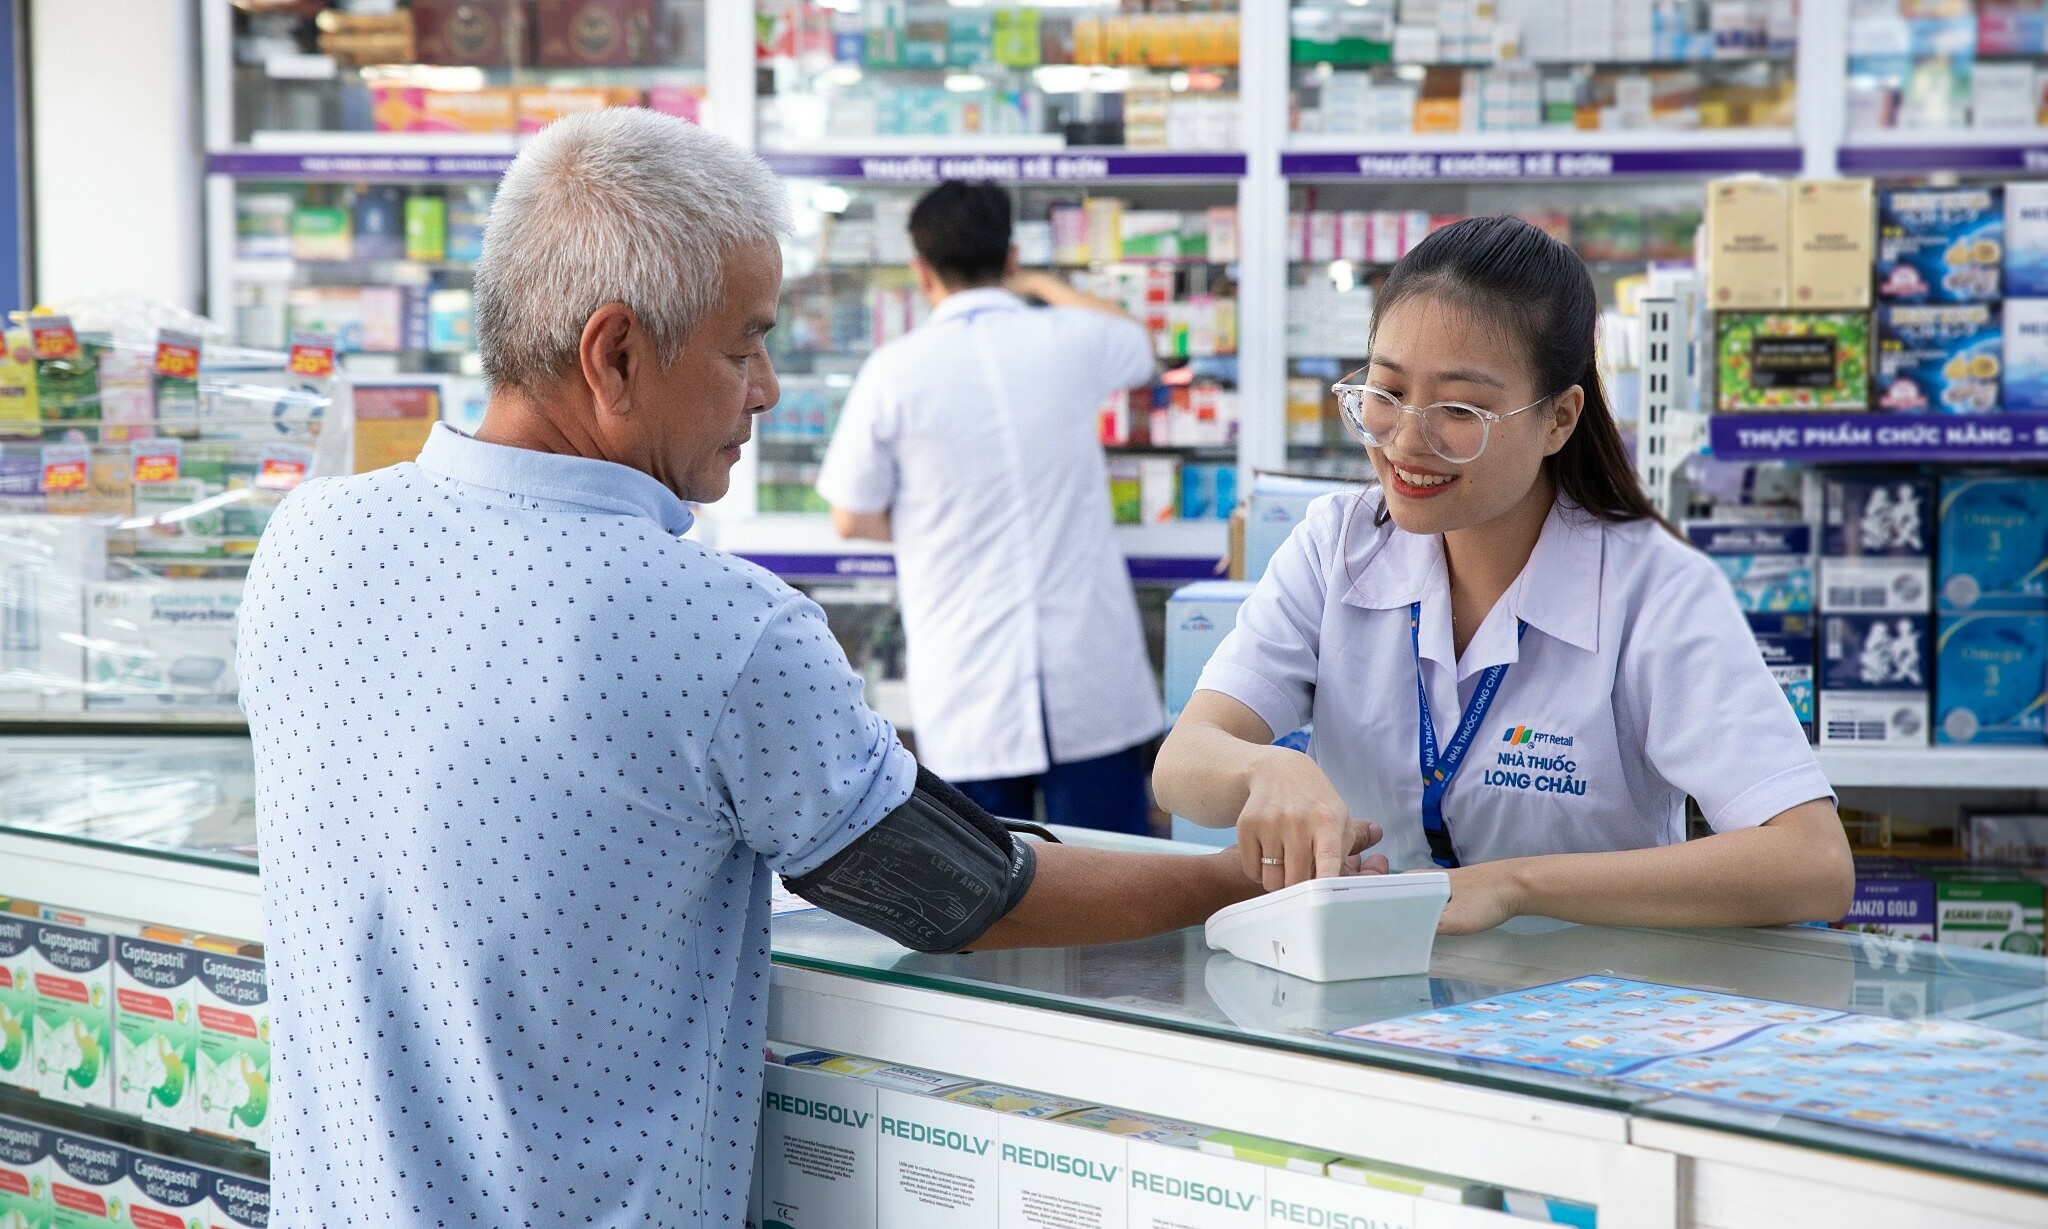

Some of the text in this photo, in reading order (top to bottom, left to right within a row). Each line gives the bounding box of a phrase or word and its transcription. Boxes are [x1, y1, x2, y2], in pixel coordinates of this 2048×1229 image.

[1422, 714, 1433, 745] THUỐC
[1447, 745, 1463, 763] NHÀ
[1458, 714, 1478, 744] THUỐC
[1473, 688, 1490, 715] LONG
[1534, 732, 1573, 746] FPT Retail
[1424, 747, 1434, 767] NHÀ
[1497, 751, 1577, 773] NHÀ THUỐC
[1484, 770, 1587, 796] LONG CHÂU
[930, 856, 984, 896] LEFT ARM
[869, 902, 903, 919] INDEX
[1887, 900, 1918, 917] GOLD
[133, 966, 177, 985] stick pack
[215, 983, 260, 1002] stick pack
[227, 1203, 250, 1220] stick
